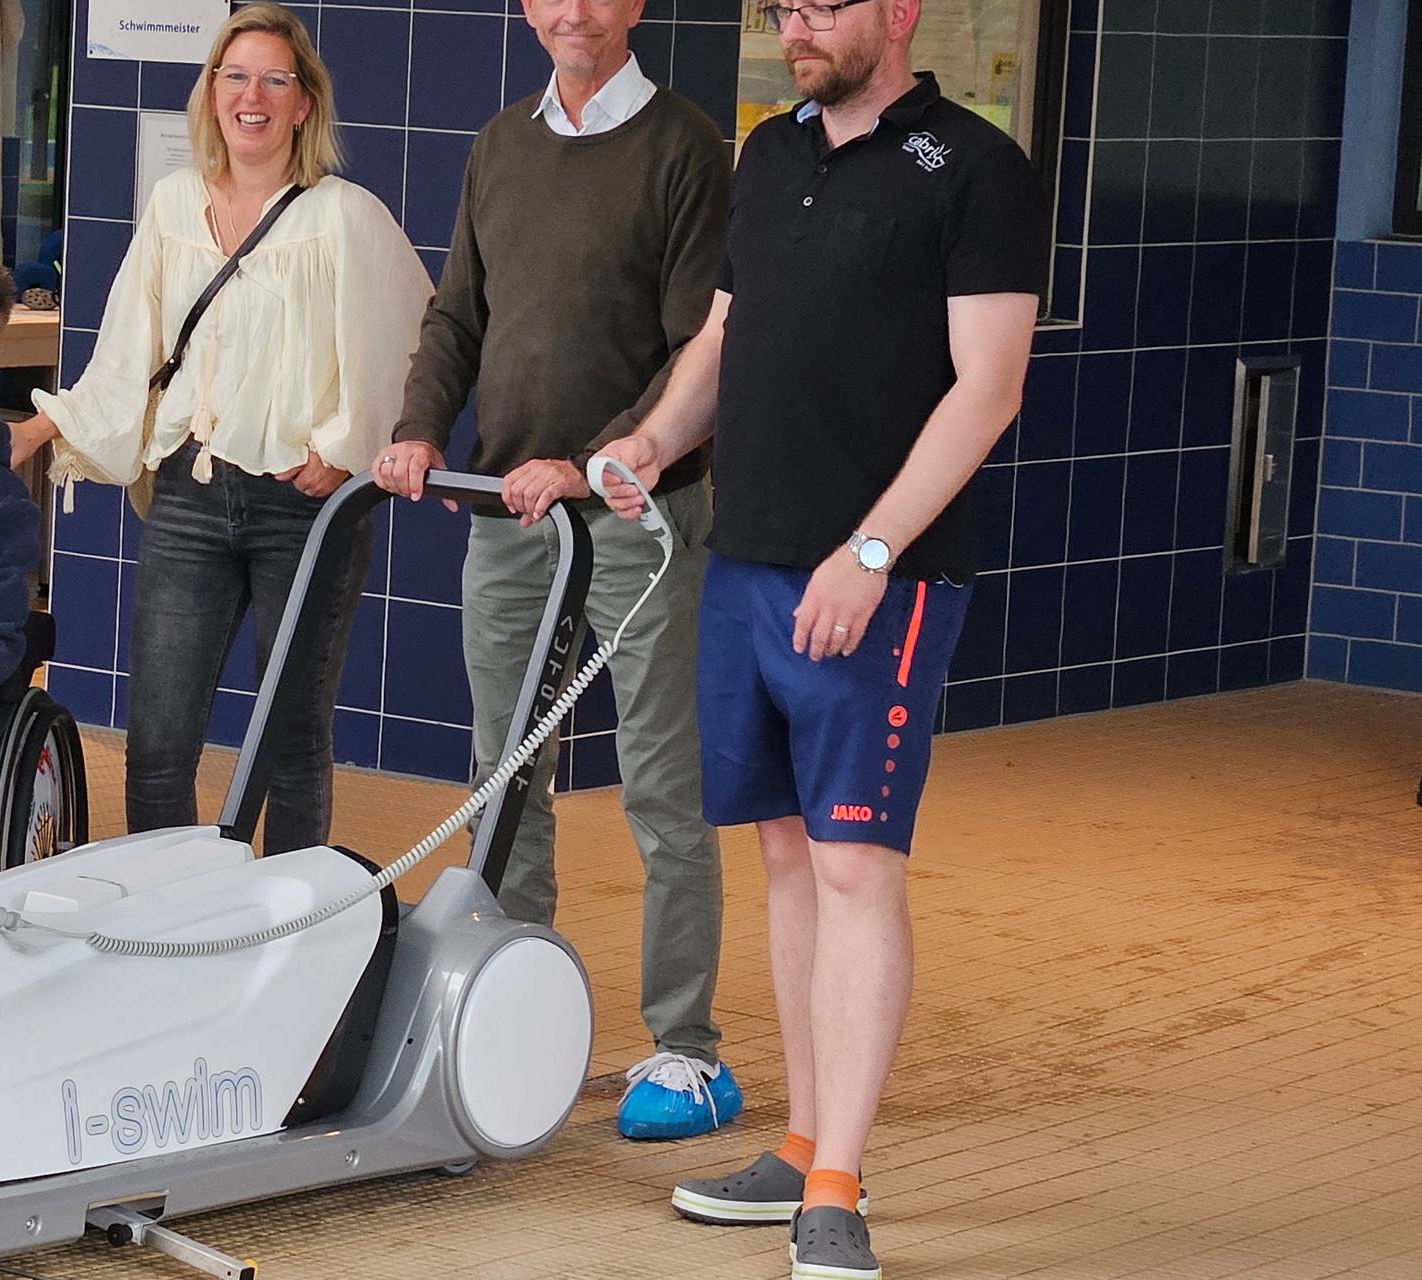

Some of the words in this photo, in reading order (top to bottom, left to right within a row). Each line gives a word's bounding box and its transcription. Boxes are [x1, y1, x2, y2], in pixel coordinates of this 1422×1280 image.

[118, 18, 201, 34] Schwimmmeister
[515, 615, 574, 792] AUTOLT
[830, 804, 873, 822] JAKO
